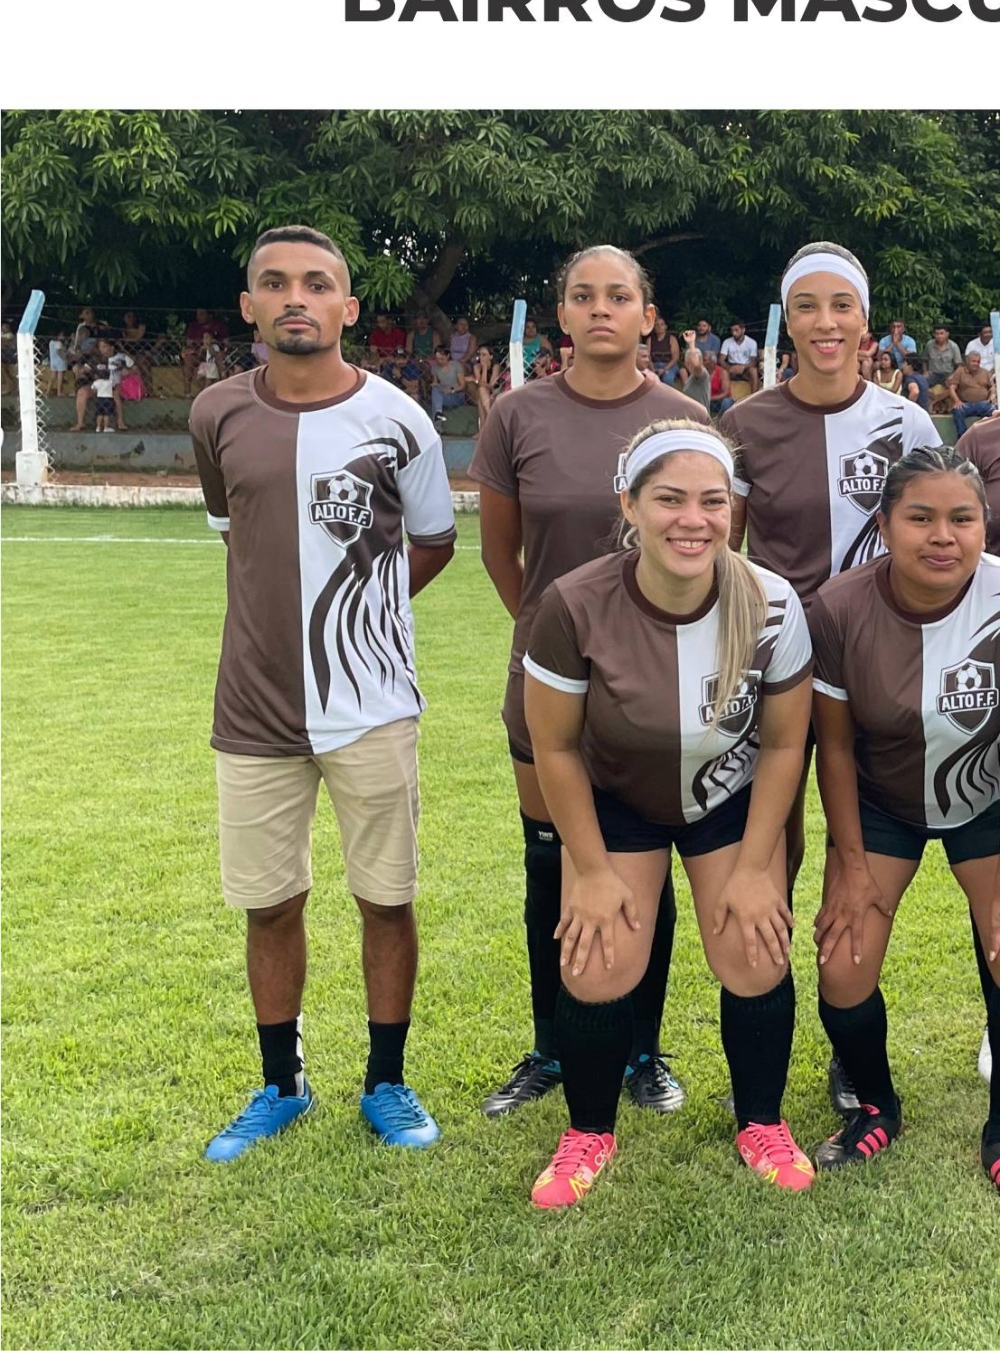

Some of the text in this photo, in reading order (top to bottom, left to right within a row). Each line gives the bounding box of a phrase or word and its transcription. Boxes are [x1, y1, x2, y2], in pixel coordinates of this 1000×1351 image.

[842, 478, 871, 493] ALTO
[315, 503, 370, 525] ALTO F.F.
[941, 691, 995, 712] ALTO F.F.
